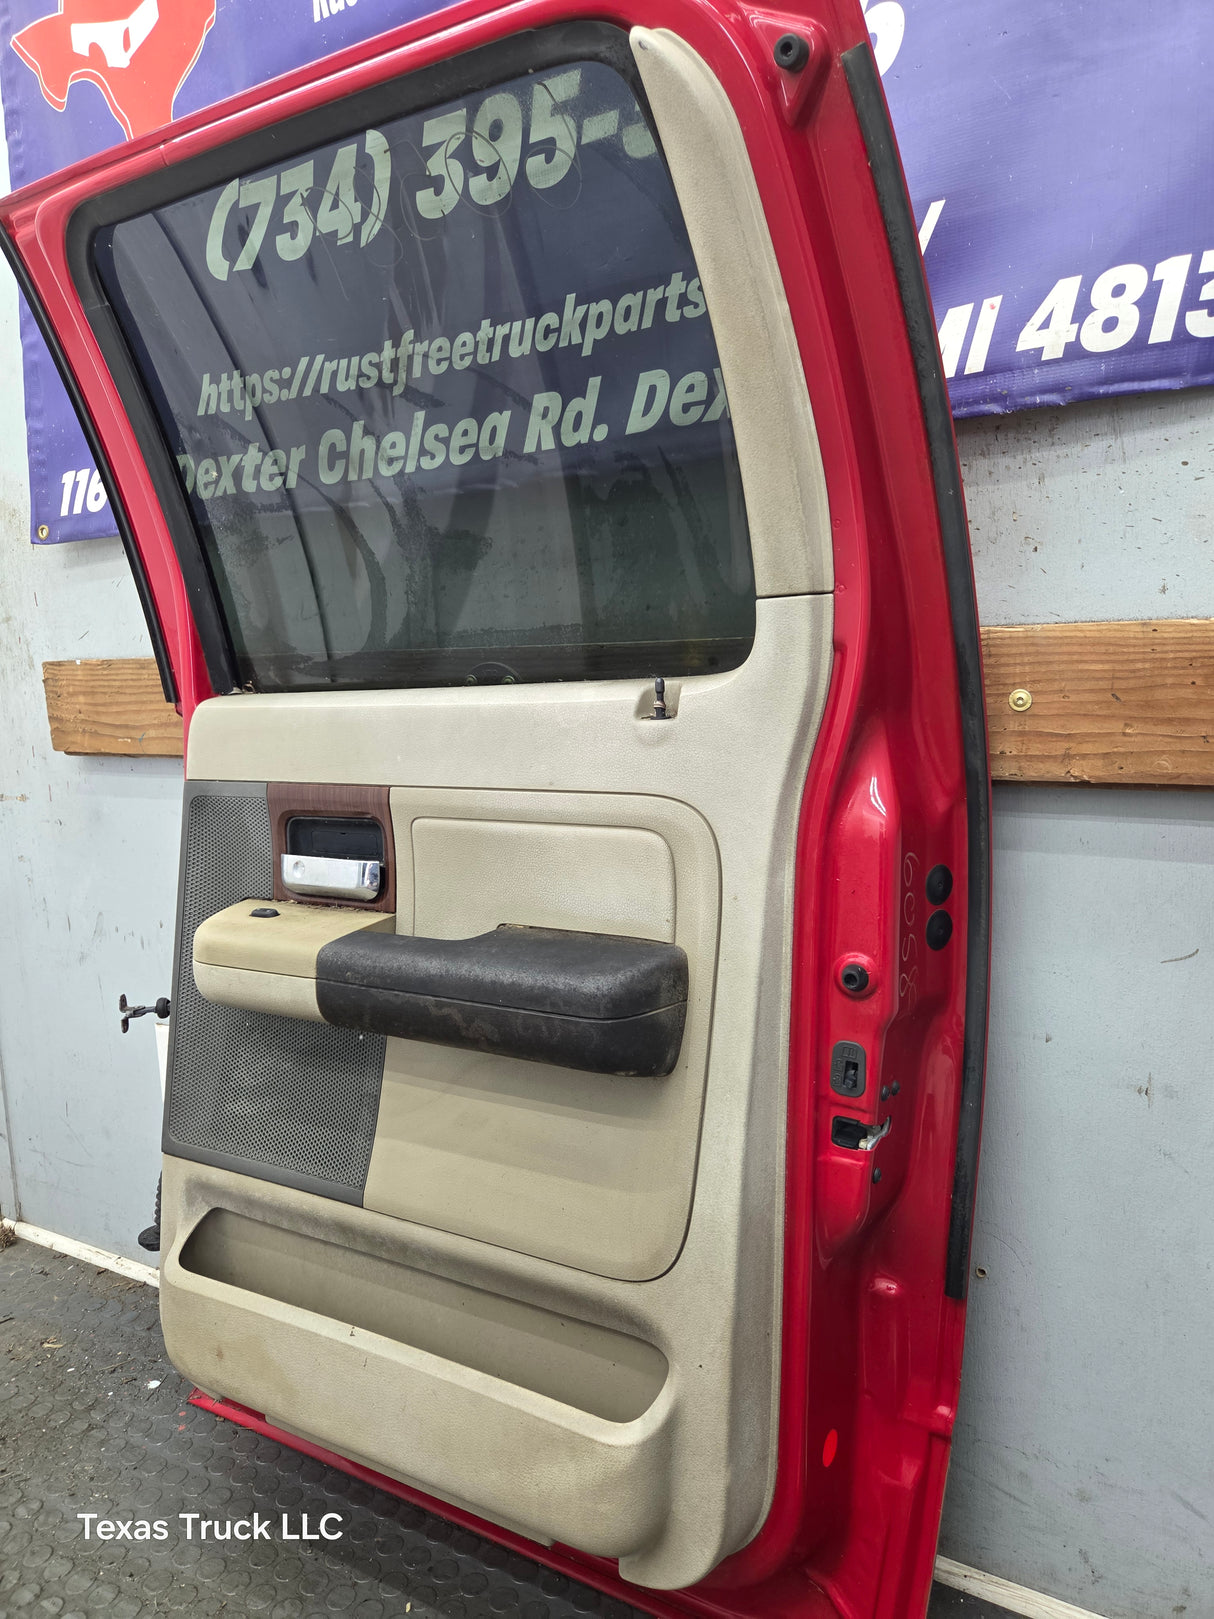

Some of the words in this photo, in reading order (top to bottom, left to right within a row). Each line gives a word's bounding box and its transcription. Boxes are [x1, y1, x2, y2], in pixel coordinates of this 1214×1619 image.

[205, 129, 392, 281] (734)
[318, 410, 511, 485] Chelsea
[524, 376, 608, 454] Rd.
